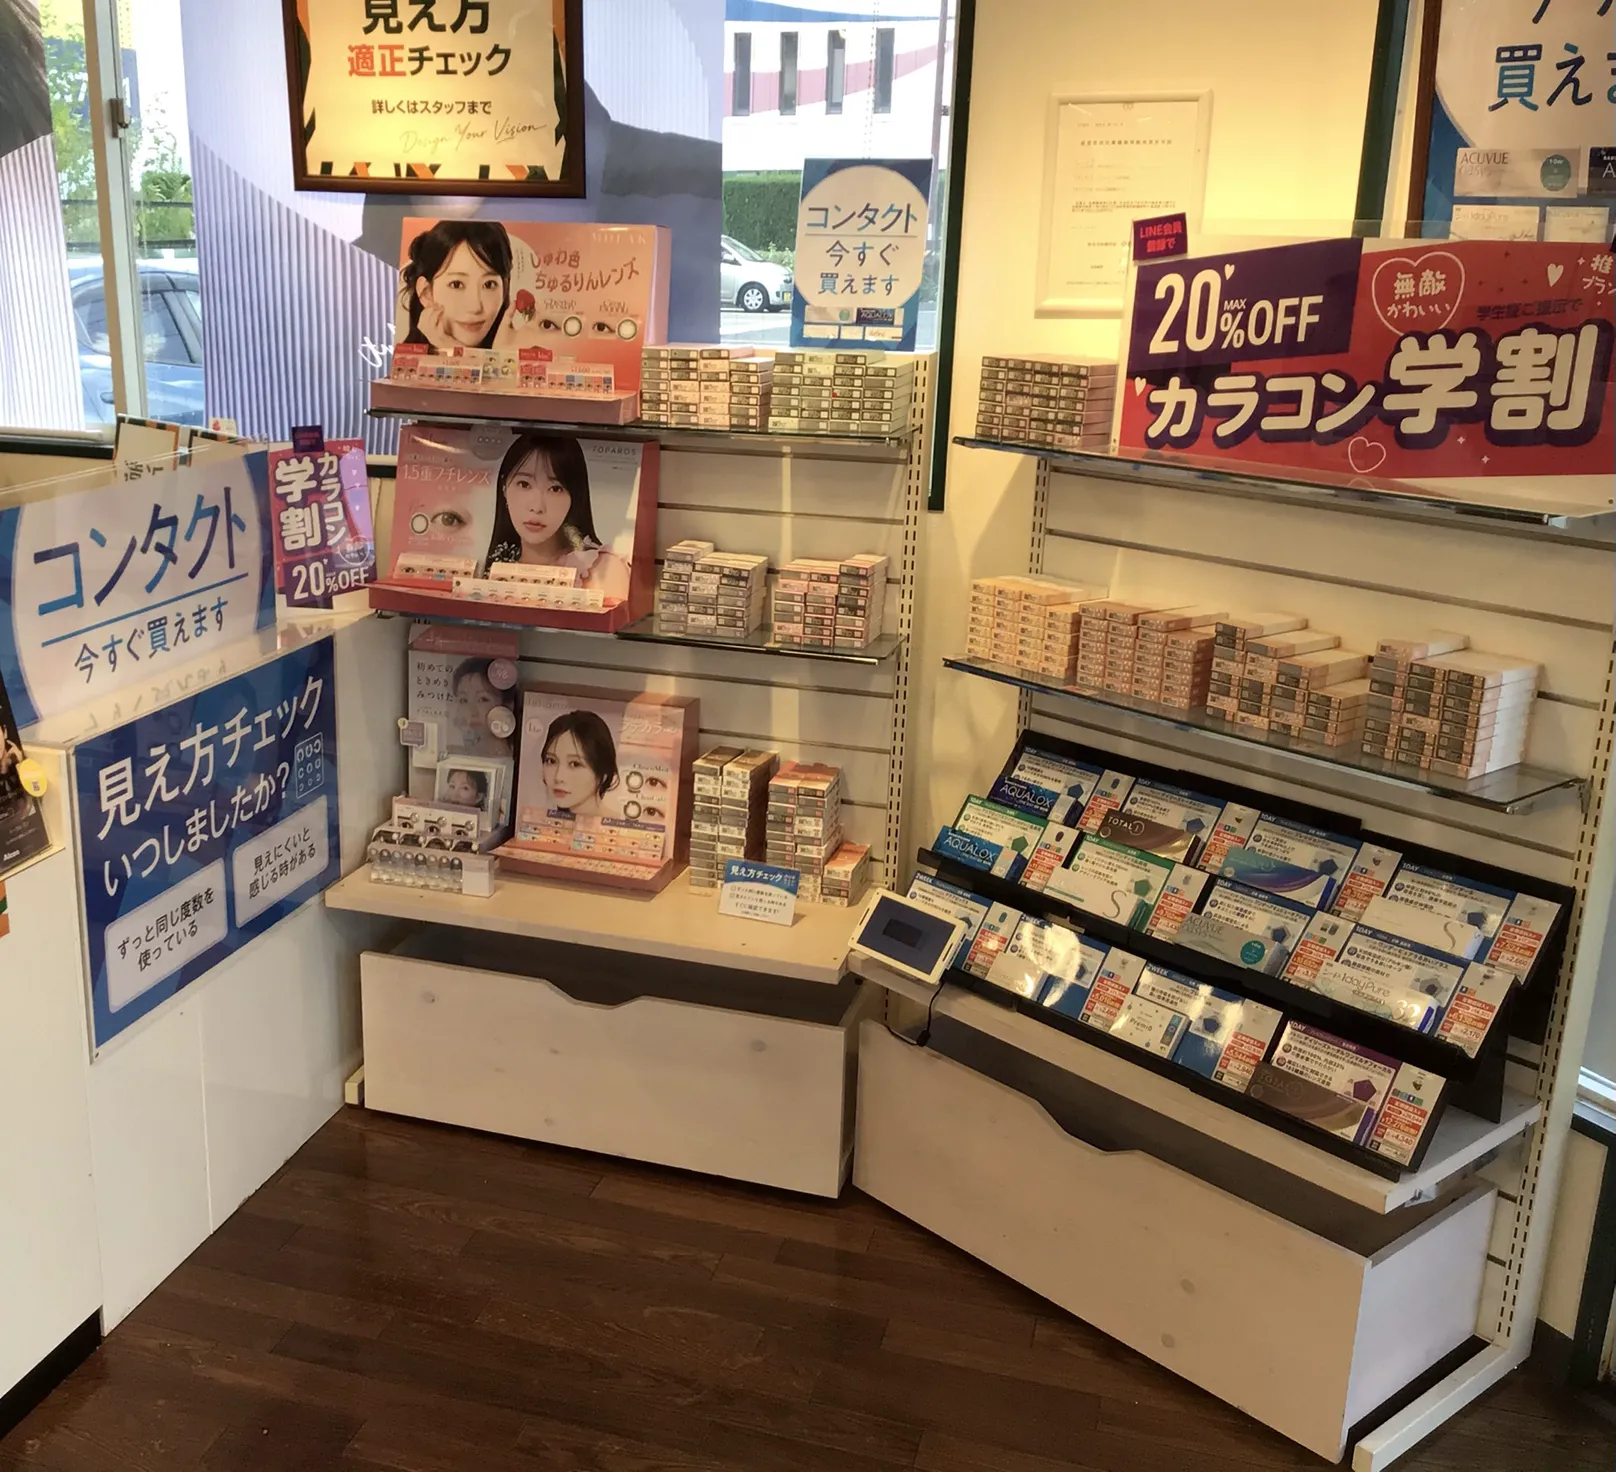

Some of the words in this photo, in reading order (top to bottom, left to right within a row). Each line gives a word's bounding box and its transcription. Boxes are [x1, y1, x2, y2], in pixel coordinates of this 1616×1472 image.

[362, 0, 489, 34] 見え方
[348, 43, 511, 77] 適正チェック
[1488, 42, 1616, 112] 買え
[371, 100, 492, 115] 詳しくはスタッフまで
[400, 129, 449, 153] Design
[454, 120, 488, 151] Your
[493, 116, 547, 144] Vision
[1460, 152, 1509, 165] ACUVUE
[807, 203, 917, 233] コンタクト
[826, 240, 899, 267] 今すぐ
[535, 256, 640, 293] ちゅるりんレンズ
[818, 272, 899, 296] 買えます
[1393, 269, 1447, 300] 無敵
[1224, 299, 1247, 310] MAX
[1387, 301, 1450, 318] かわいい
[1147, 324, 1599, 439] カラコン学割
[403, 464, 491, 486] 1.5重フチレンズ
[275, 456, 322, 551] 学割
[317, 452, 346, 546] カラコン
[34, 486, 247, 616] コンタクト
[75, 597, 228, 684] 今すぐ買えます
[97, 676, 323, 840] 見え方チェック
[1000, 783, 1053, 808] AQUALOX
[105, 762, 290, 896] いつしましたか?
[1108, 816, 1134, 831] TOTAL
[1261, 813, 1277, 823] 1DAY
[253, 827, 311, 875] 見えにくいと
[943, 837, 996, 861] AQUALOX
[248, 843, 316, 899] 感じる時がある
[730, 865, 783, 882] 見え方チェック
[1402, 862, 1420, 872] 1DAY
[1217, 878, 1233, 889] 1DAY
[118, 888, 214, 960] ずっと同じ度数を
[1187, 914, 1225, 936] ACUVUE
[1356, 925, 1373, 936] 1DAY
[138, 921, 198, 971] 使っている
[1147, 964, 1169, 977] 2WEEK
[1341, 973, 1390, 998] 1dayPure
[1289, 1020, 1306, 1031] 1DAY
